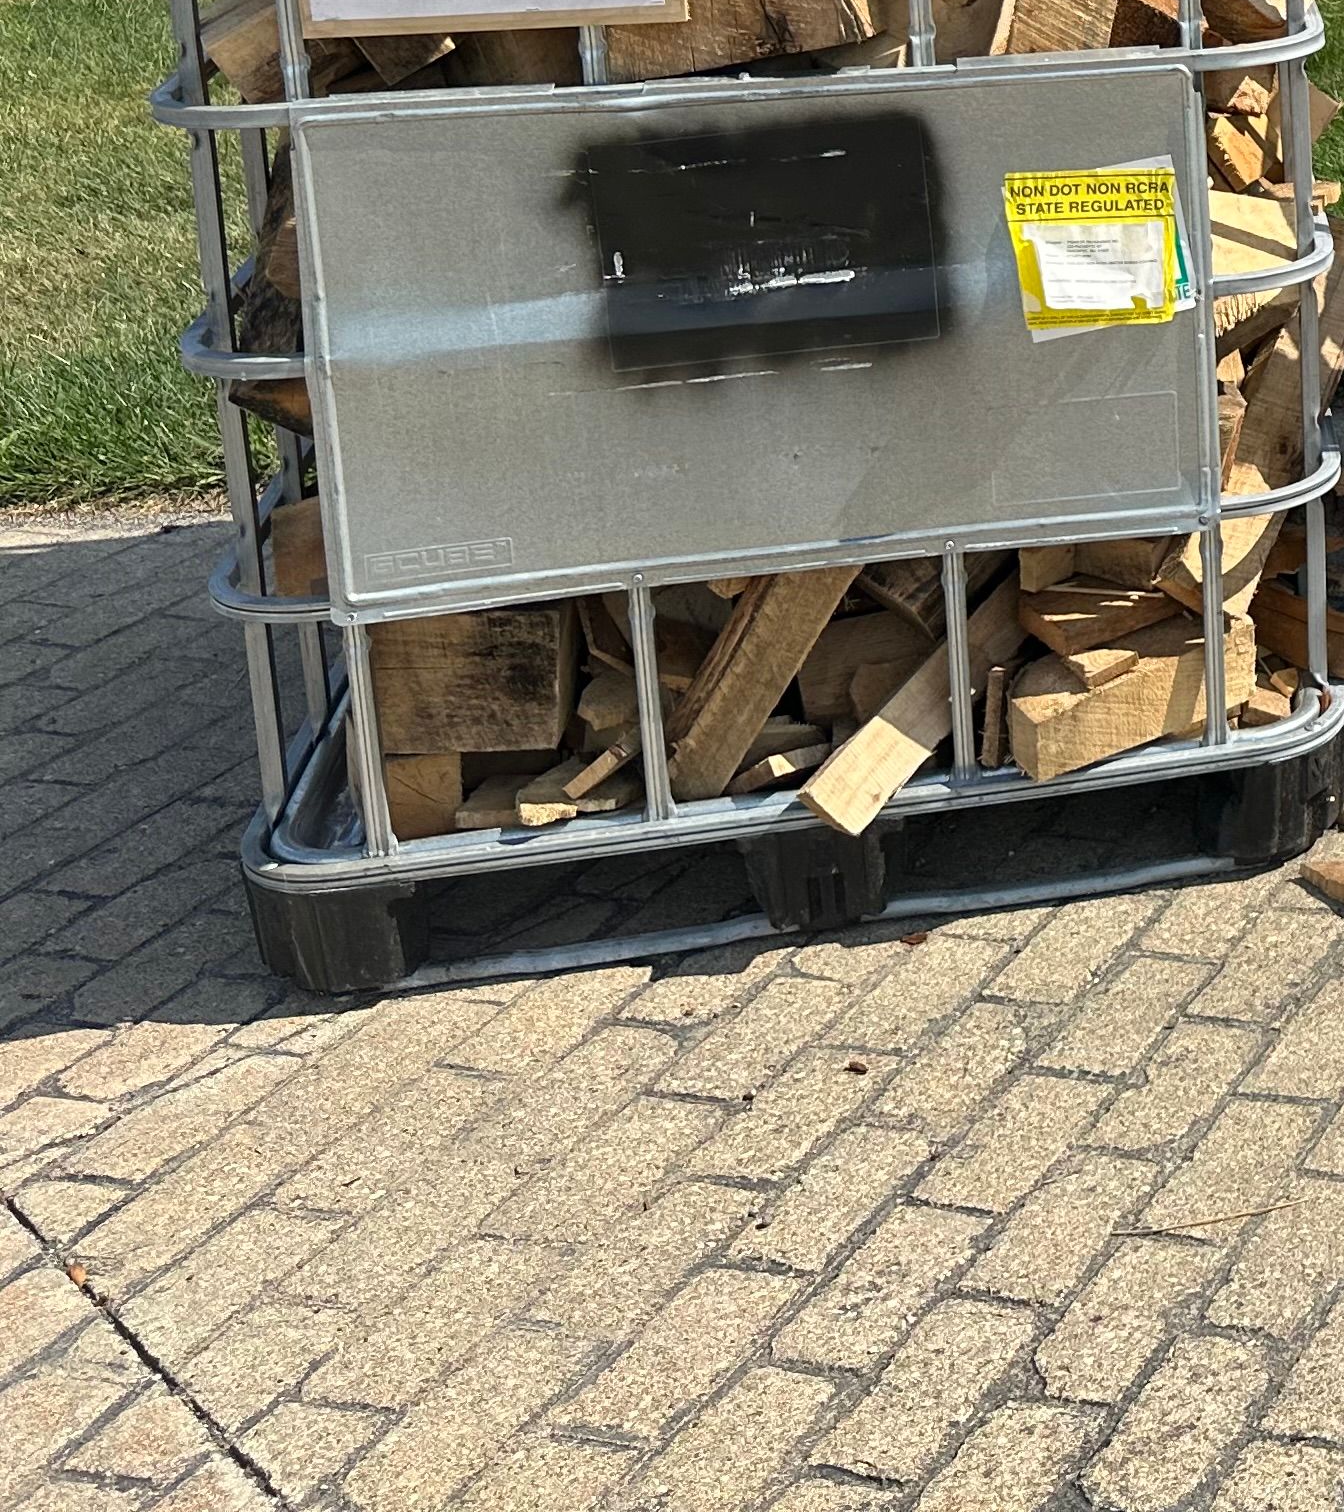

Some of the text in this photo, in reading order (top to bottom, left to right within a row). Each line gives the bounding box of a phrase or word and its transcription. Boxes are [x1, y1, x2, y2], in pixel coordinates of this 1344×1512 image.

[1010, 181, 1170, 199] NON DOT NON RCRA
[1016, 198, 1166, 216] STATE REGULATED
